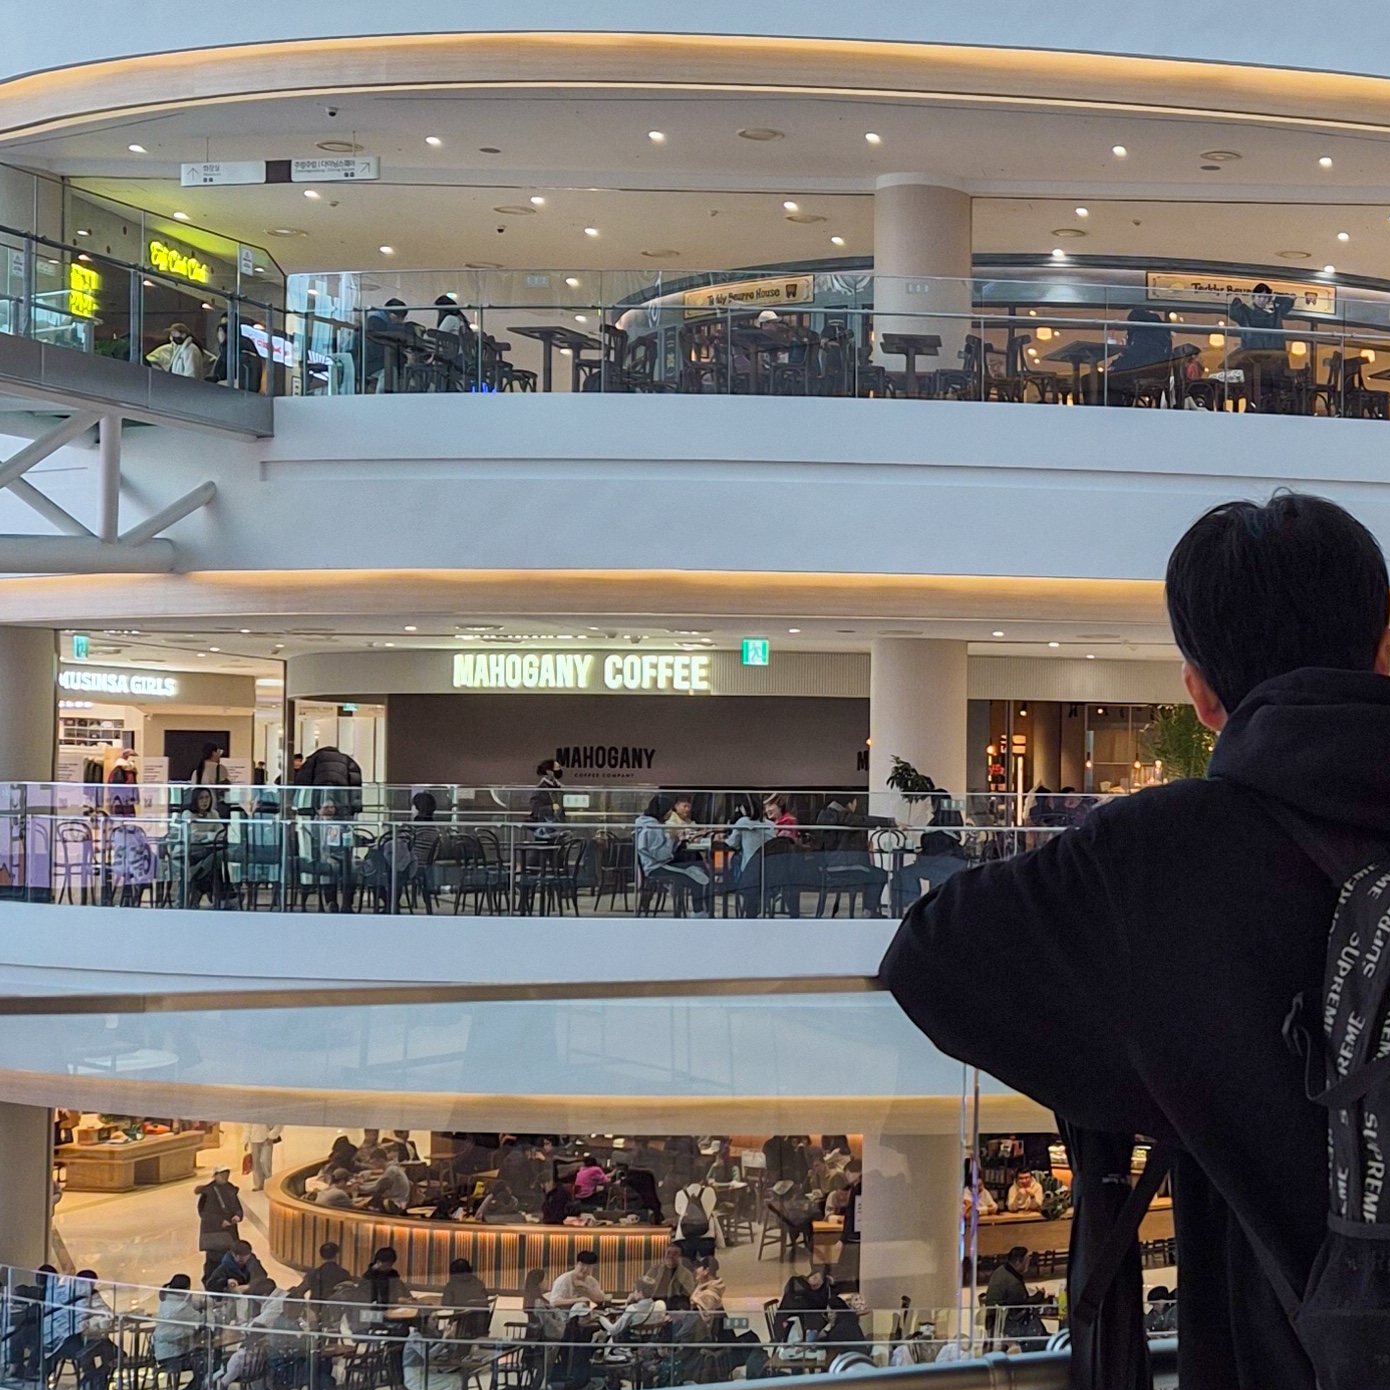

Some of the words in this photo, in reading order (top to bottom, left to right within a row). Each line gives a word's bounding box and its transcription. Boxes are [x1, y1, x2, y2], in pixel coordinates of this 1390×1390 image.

[452, 653, 594, 689] MAHOGANY
[603, 654, 711, 690] COFFEE
[130, 675, 176, 697] GIRLS
[556, 746, 656, 769] MAHOGANY
